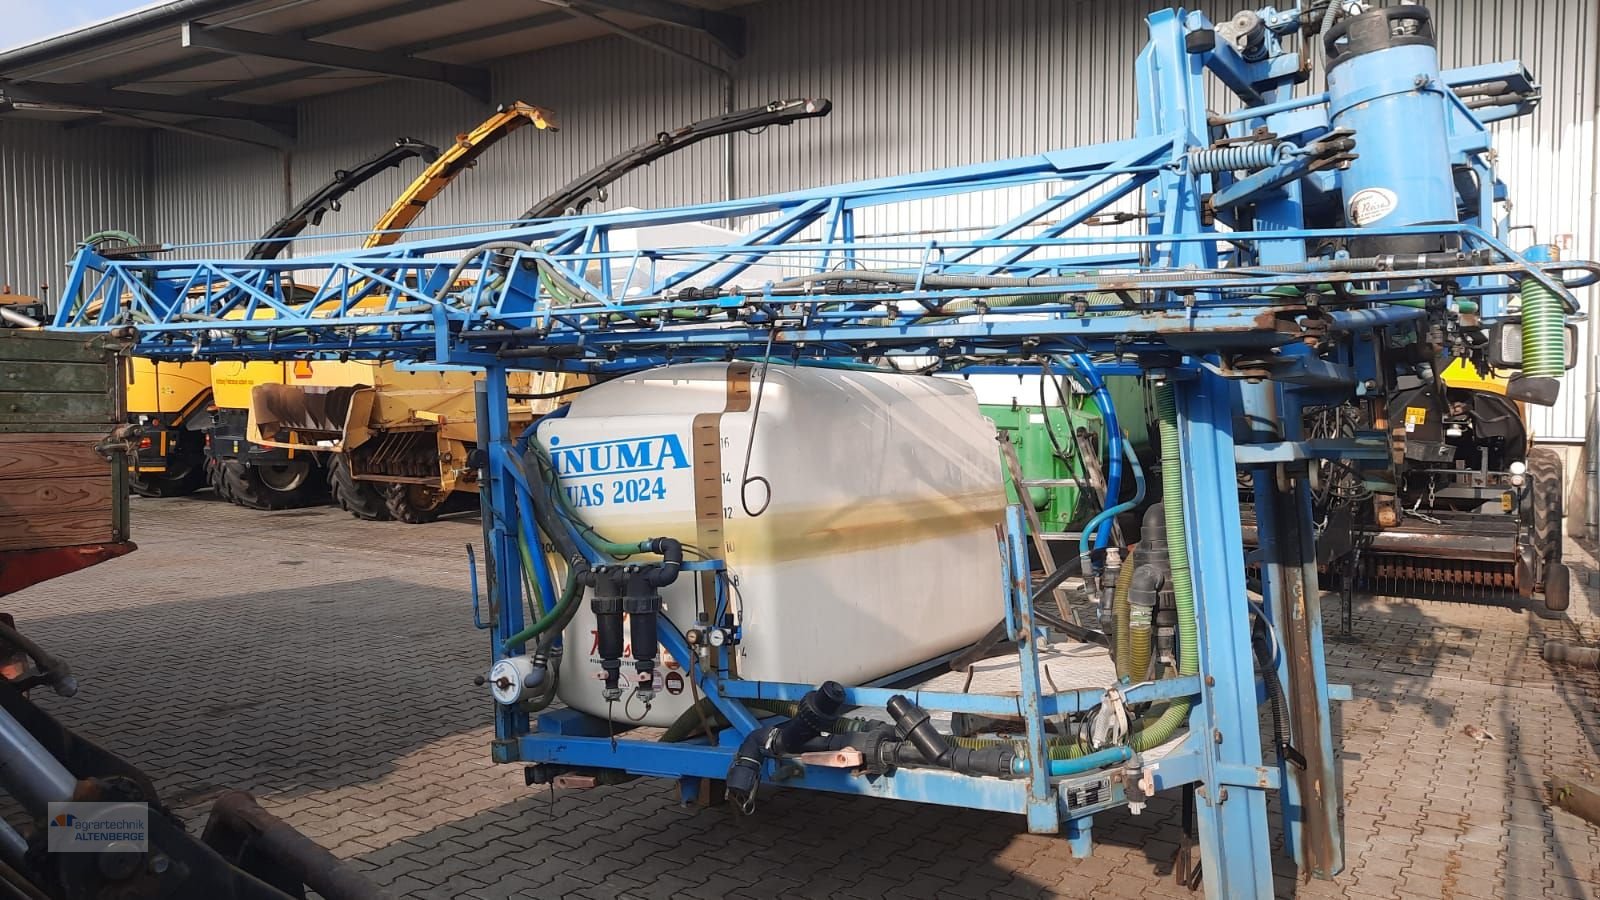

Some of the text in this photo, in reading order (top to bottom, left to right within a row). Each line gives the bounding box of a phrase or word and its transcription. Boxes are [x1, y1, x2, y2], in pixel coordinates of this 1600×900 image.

[720, 436, 730, 449] 16
[722, 472, 732, 485] 14
[612, 476, 667, 504] 2024
[723, 506, 733, 519] 12
[726, 540, 736, 553] 10
[733, 574, 740, 587] 8
[741, 646, 747, 657] 4
